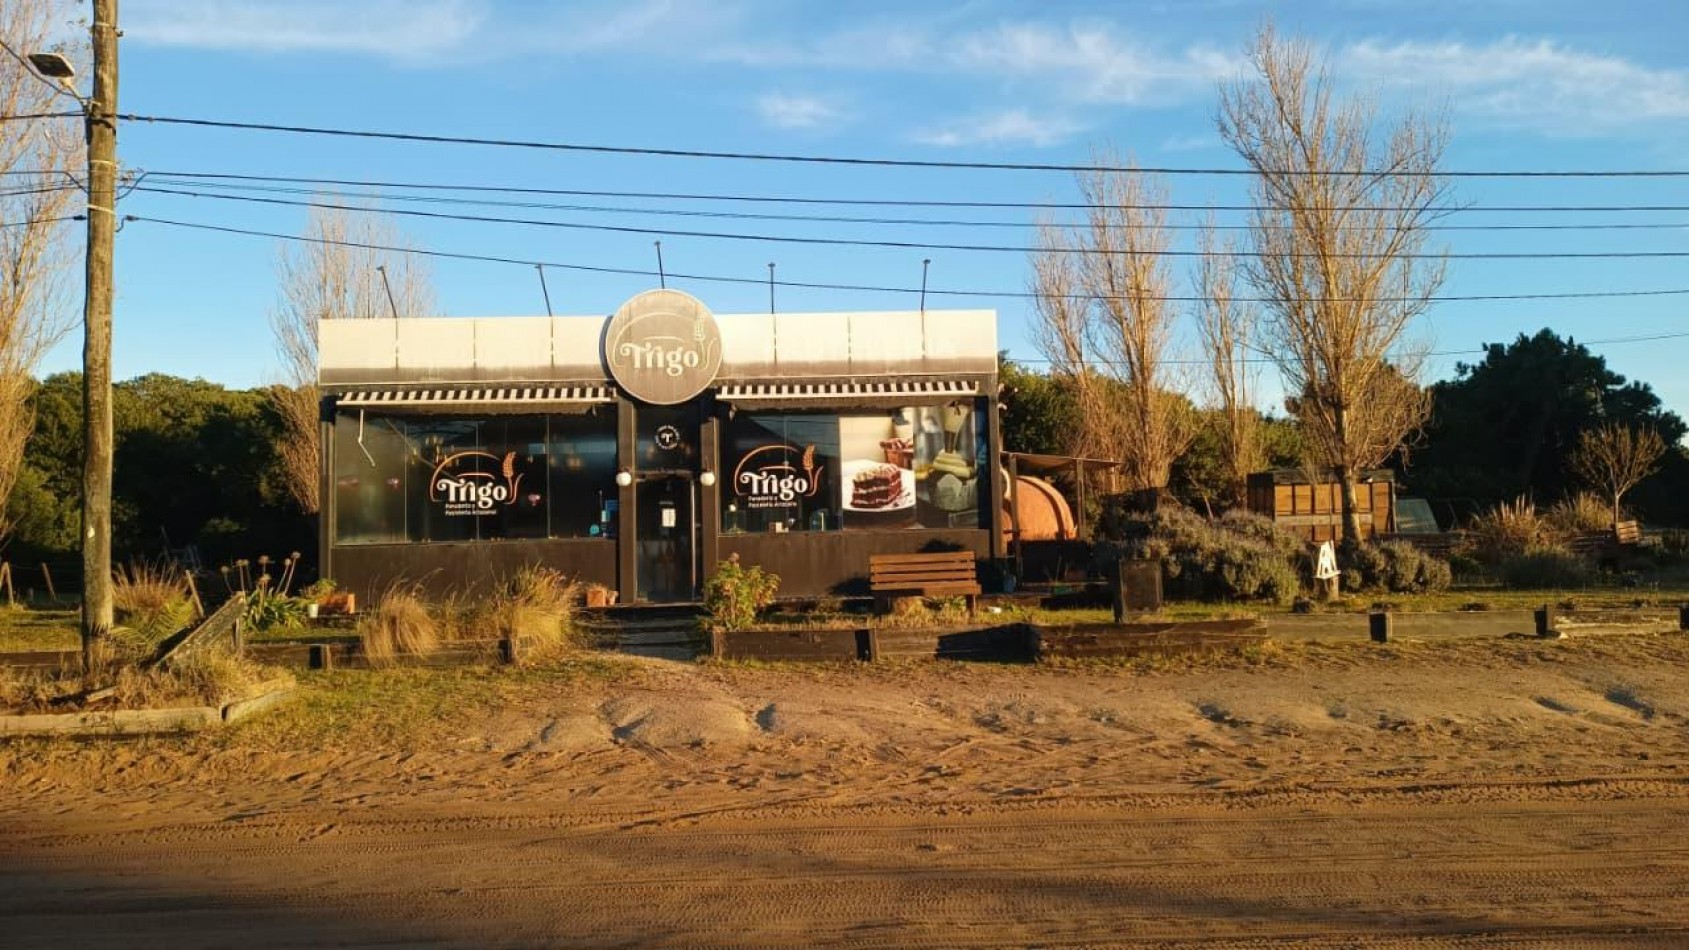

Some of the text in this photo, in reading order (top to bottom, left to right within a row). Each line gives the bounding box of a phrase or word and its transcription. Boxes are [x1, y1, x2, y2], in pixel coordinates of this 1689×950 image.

[620, 342, 699, 377] Trigo
[436, 478, 507, 509] Trigo
[740, 471, 808, 501] Trigo
